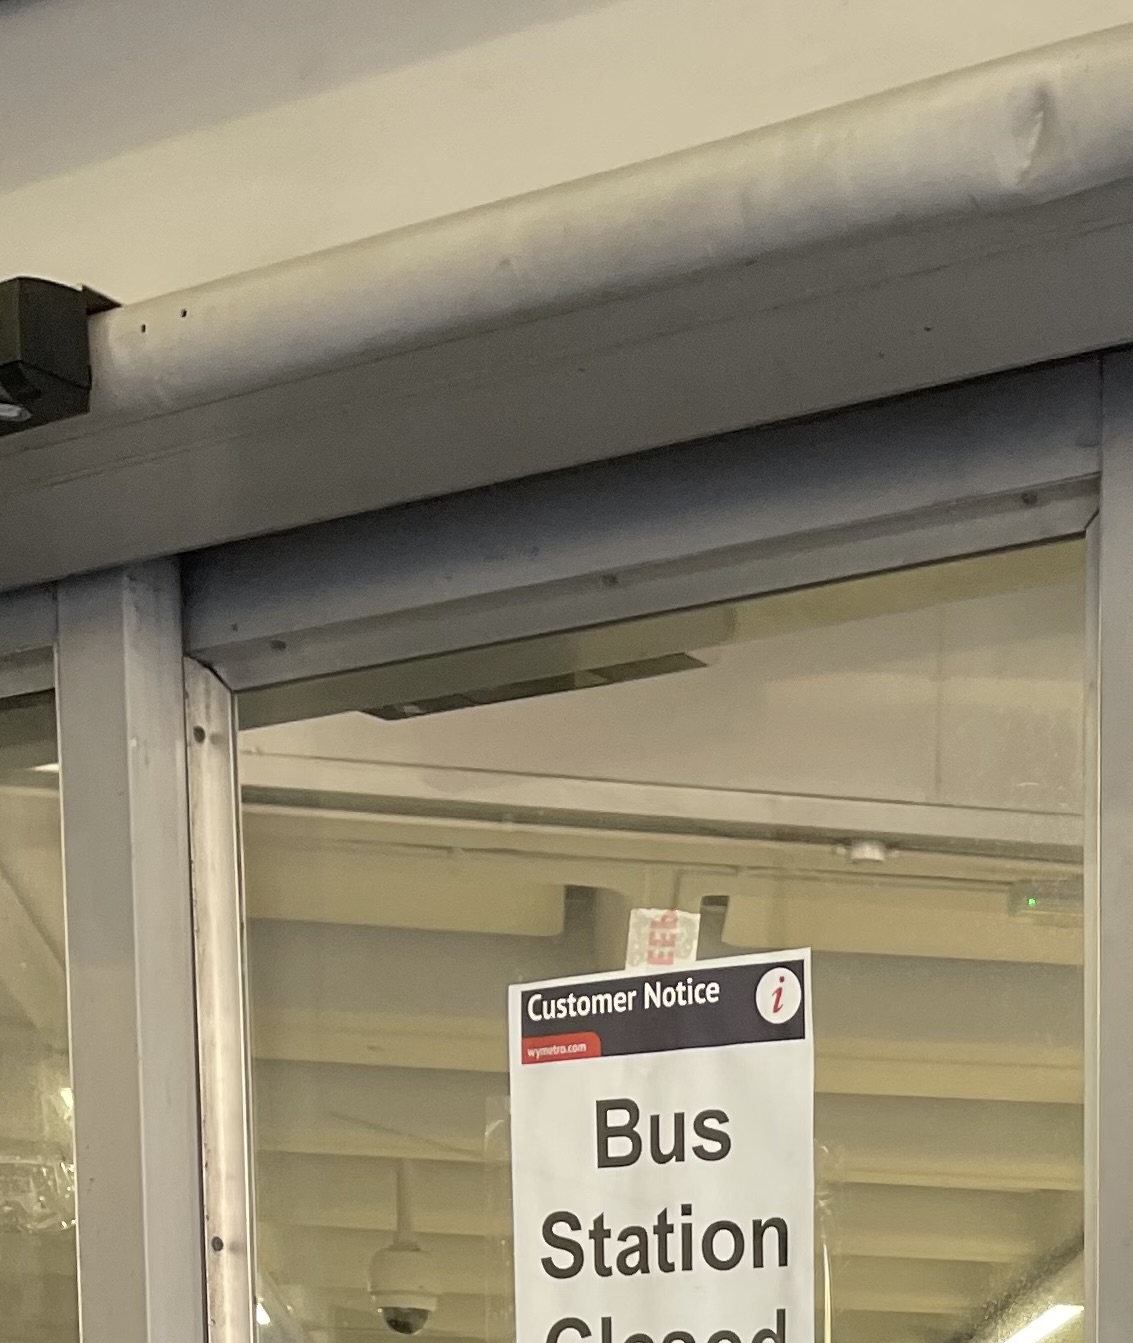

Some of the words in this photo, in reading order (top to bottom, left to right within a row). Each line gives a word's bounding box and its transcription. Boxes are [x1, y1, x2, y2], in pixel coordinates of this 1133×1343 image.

[527, 989, 637, 1022] Customer
[643, 977, 721, 1010] Notice
[526, 1043, 587, 1060] wymetro.com
[595, 1097, 732, 1169] Bus
[540, 1203, 789, 1280] Station
